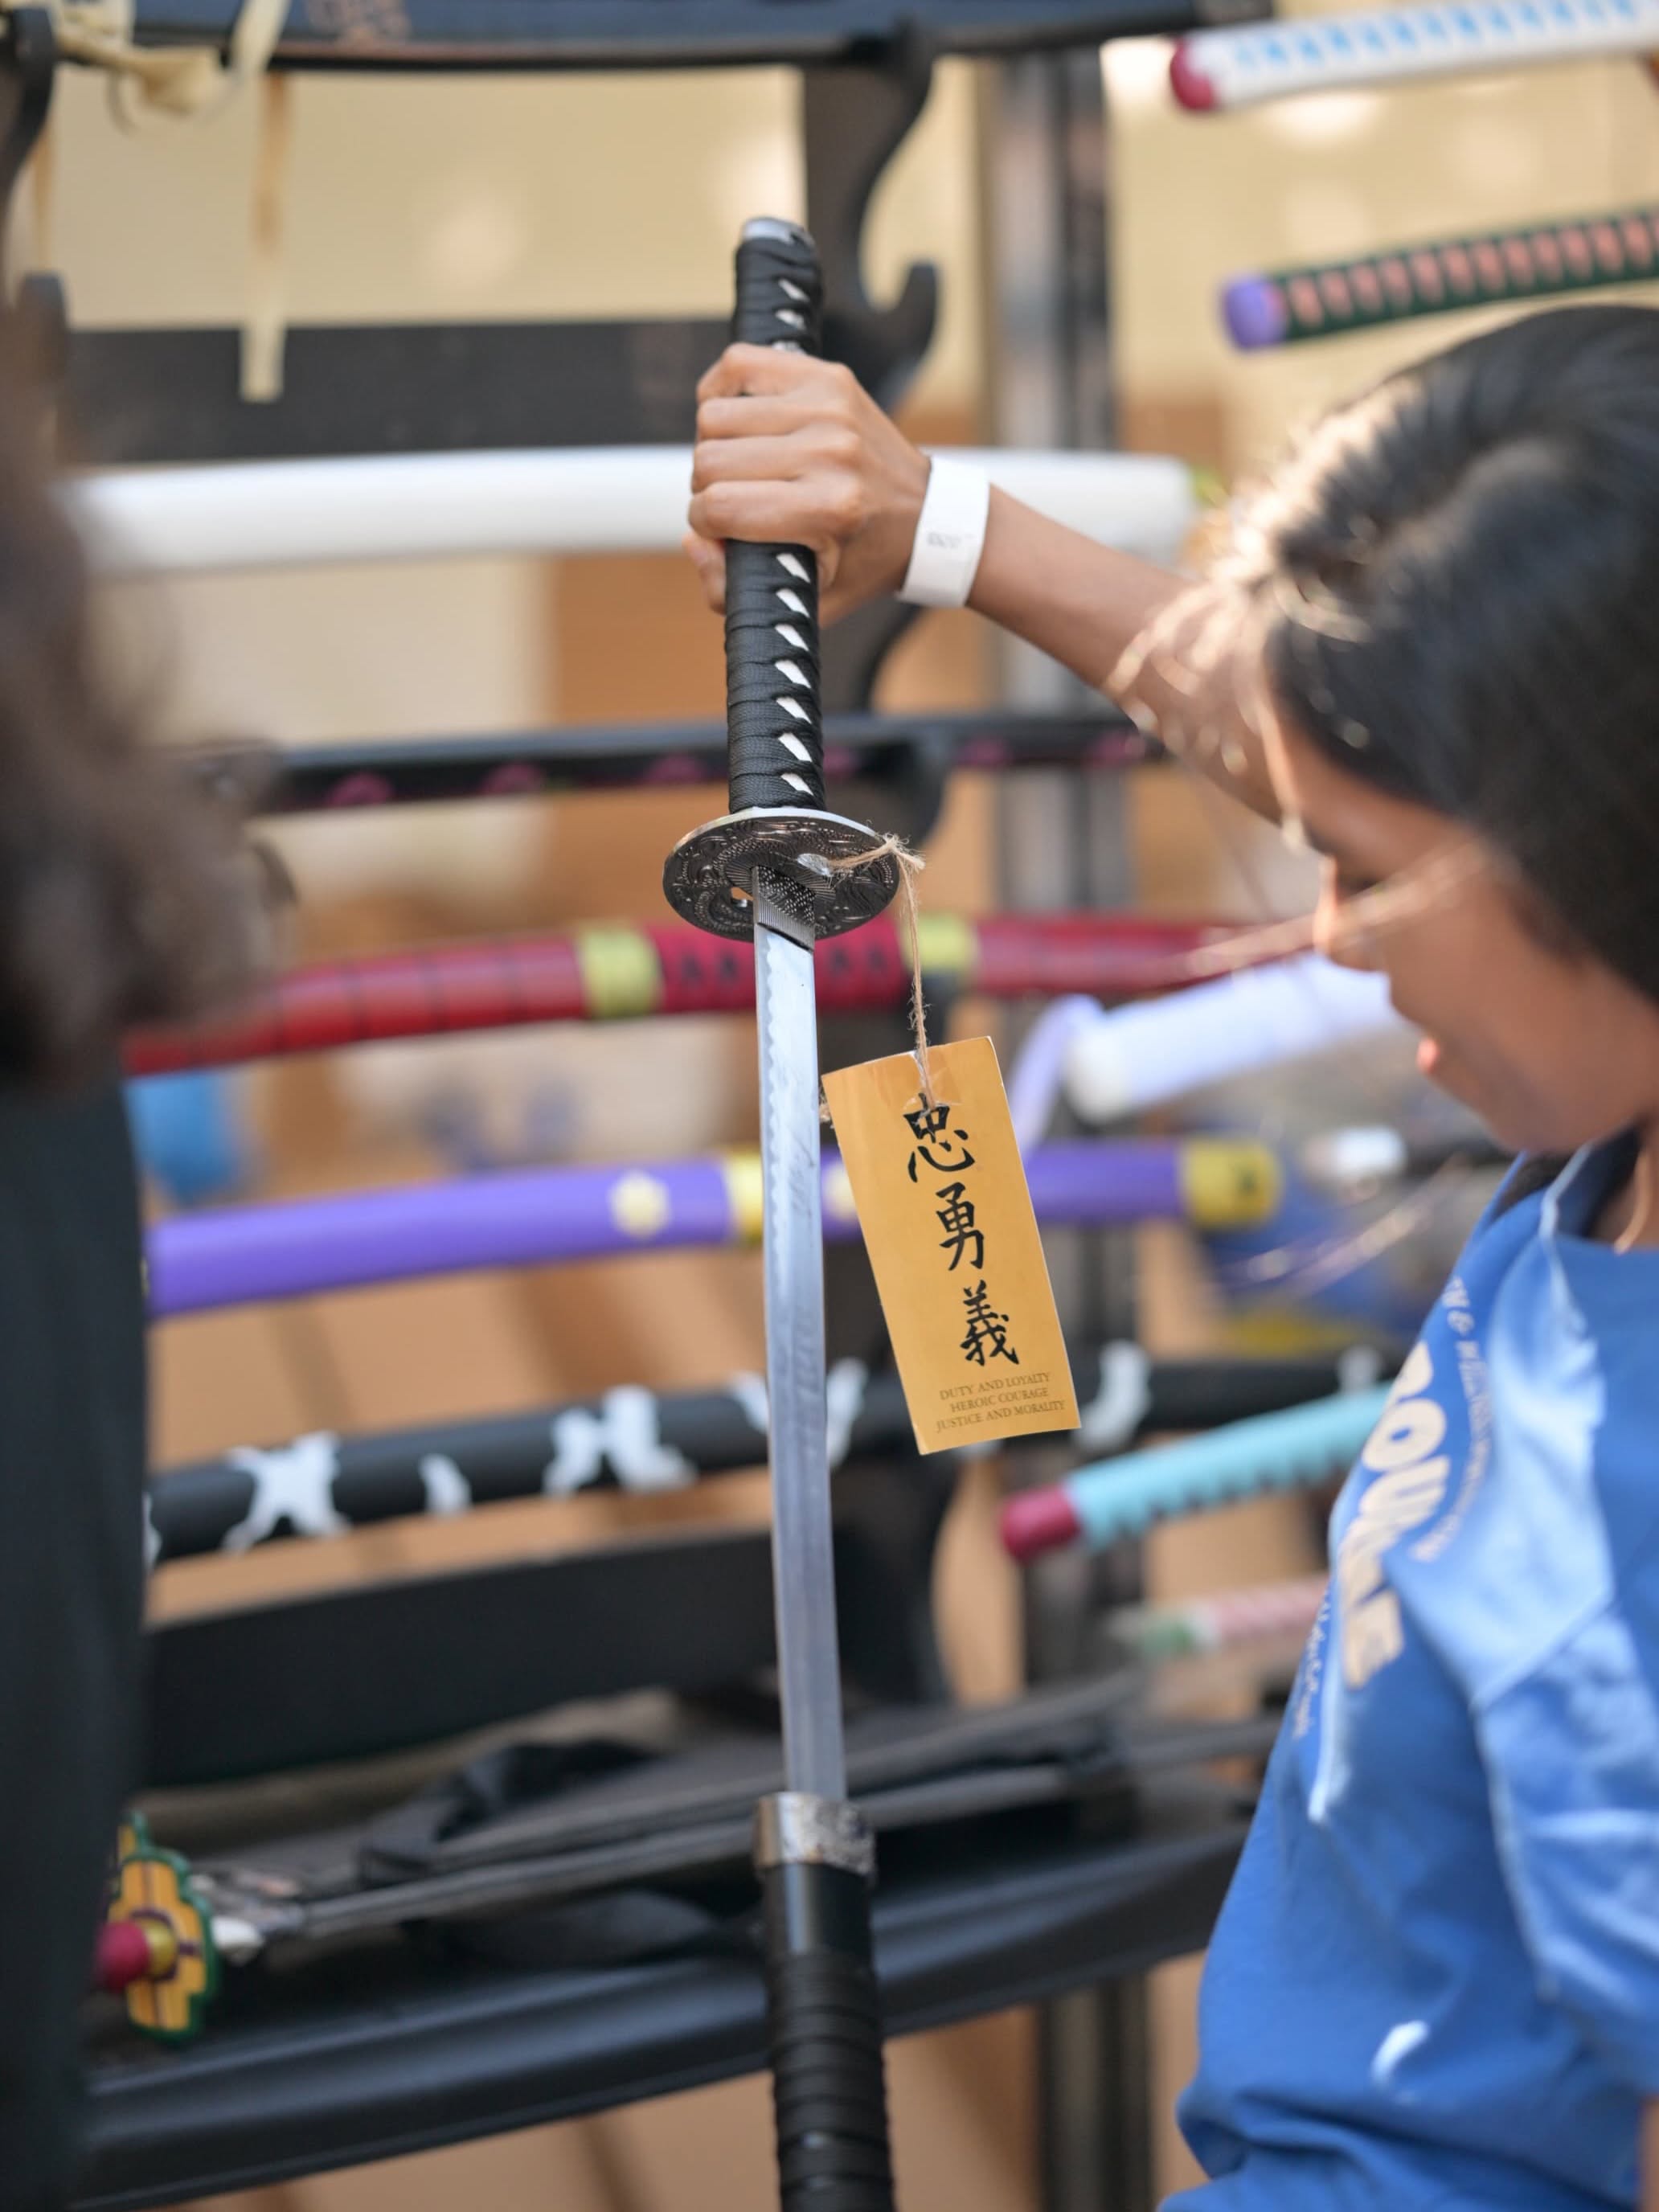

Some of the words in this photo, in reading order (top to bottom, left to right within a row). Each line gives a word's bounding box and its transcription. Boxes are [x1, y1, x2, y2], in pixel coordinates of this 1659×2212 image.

[903, 1092, 1020, 1366] 忠勇義
[940, 1385, 973, 1399] DUTY
[977, 1379, 1004, 1393] AND
[1006, 1373, 1050, 1387] LOYALTY
[950, 1395, 997, 1412] HEROIC
[998, 1388, 1048, 1403] COURAGE
[936, 1414, 983, 1432] JUSTICE
[986, 1407, 1011, 1419] AND
[1014, 1401, 1064, 1415] MORALITY
